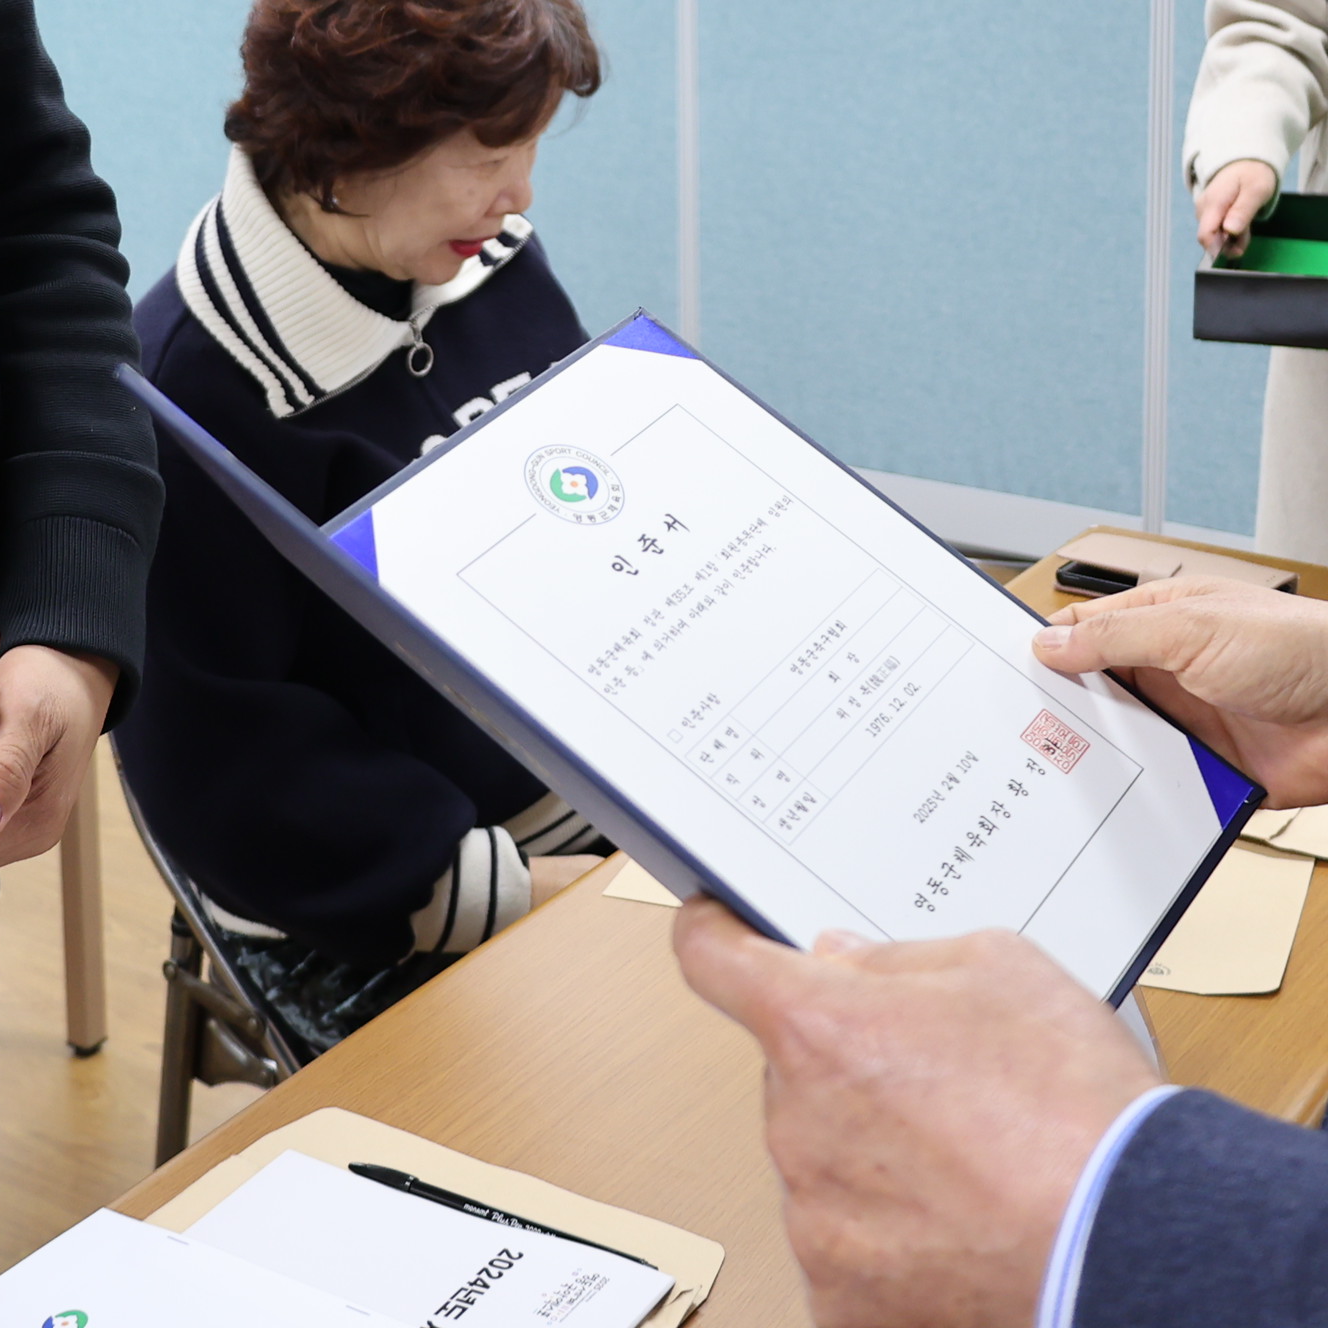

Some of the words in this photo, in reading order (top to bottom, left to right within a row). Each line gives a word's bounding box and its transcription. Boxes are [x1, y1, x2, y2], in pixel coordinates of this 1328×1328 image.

[544, 447, 572, 457] SPORT
[575, 450, 610, 476] COUNCIL
[588, 628, 642, 676] 영동군체육회
[643, 609, 664, 627] 정관
[665, 584, 694, 606] 제35조
[695, 561, 718, 580] 제1항
[768, 495, 794, 517] 임원의
[604, 676, 626, 695] 인준
[654, 619, 690, 651] 의거하여
[689, 595, 716, 618] 아래와
[714, 579, 734, 596] 같이
[733, 544, 776, 580] 인준합니다.
[682, 693, 720, 728] 인준사항
[865, 713, 893, 737] 1976.
[889, 698, 907, 712] 12.
[904, 682, 921, 696] 02.
[779, 792, 816, 830] 생년월일
[913, 790, 945, 824] 2025년
[941, 772, 960, 791] 2월
[956, 751, 979, 774] 10일
[434, 1248, 524, 1320] 2024년도
